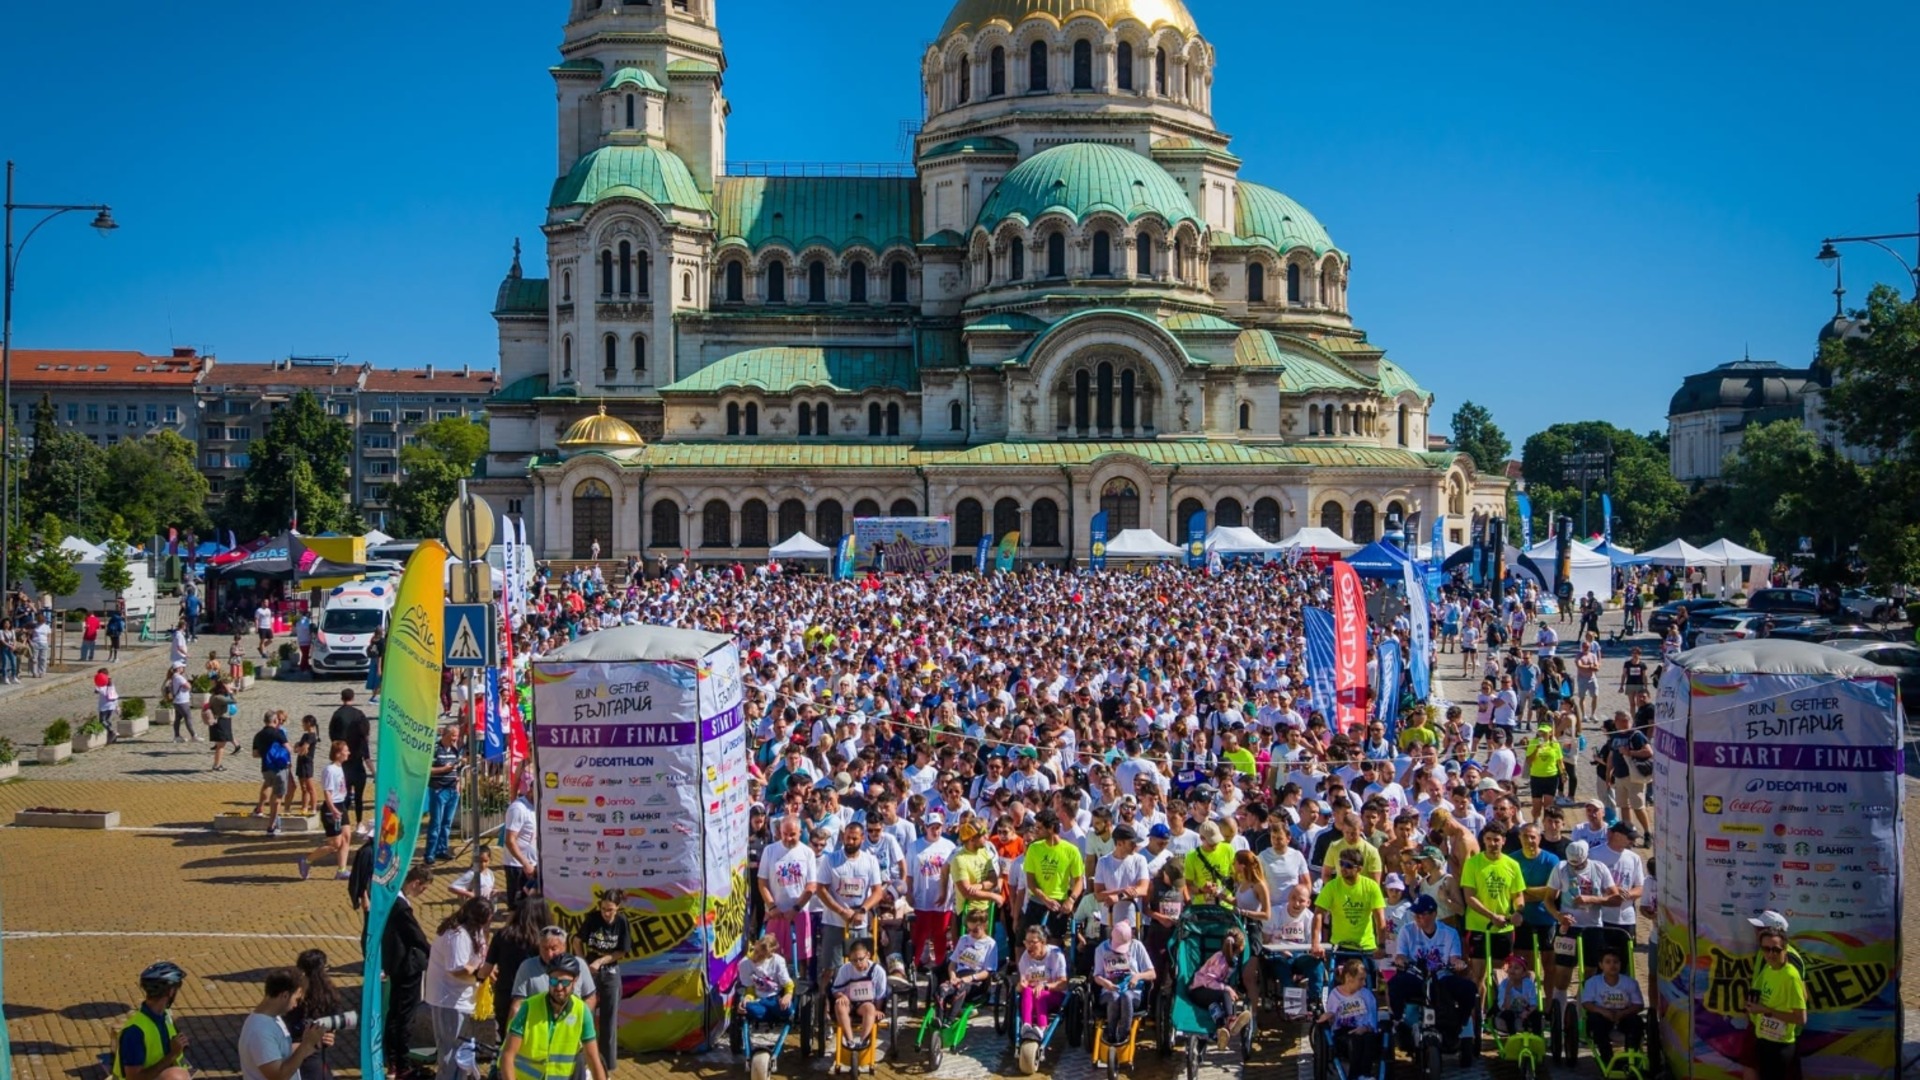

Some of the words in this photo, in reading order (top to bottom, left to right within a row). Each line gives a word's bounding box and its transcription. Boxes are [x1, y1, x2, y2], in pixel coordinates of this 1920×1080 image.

[249, 548, 289, 559] IDAS
[573, 696, 652, 721] БЪЛГАРИЯ
[1746, 714, 1844, 739] БЪЛГАРИЯ
[401, 731, 432, 754] СОФИЯ
[550, 728, 601, 744] START
[627, 726, 679, 743] FINAL
[589, 757, 654, 767] DECATHLON
[1715, 746, 1782, 765] START
[1815, 748, 1877, 768] FINAL
[1766, 781, 1847, 793] DECATHLON
[606, 796, 636, 806] Jamba
[1788, 826, 1824, 837] Jamba
[1817, 846, 1855, 855] БАНКЯ
[1708, 962, 1887, 1012] ПОНЕШ
